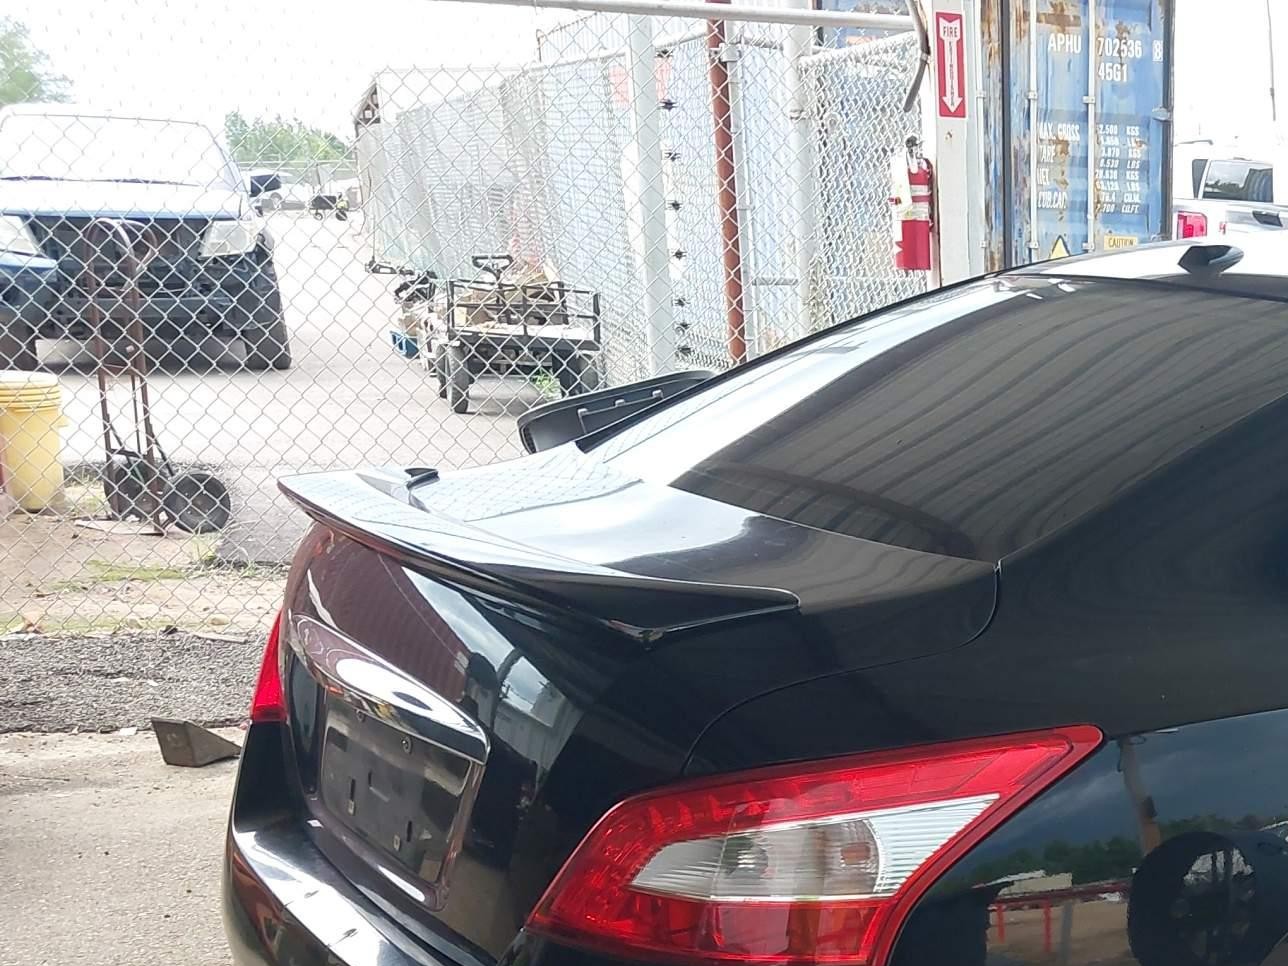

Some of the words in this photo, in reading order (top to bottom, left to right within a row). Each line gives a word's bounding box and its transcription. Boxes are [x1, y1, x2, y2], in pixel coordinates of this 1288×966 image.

[942, 26, 959, 38] FIRE
[1047, 32, 1083, 54] APHU
[1097, 37, 1142, 59] 702536
[1098, 62, 1128, 82] 45G1
